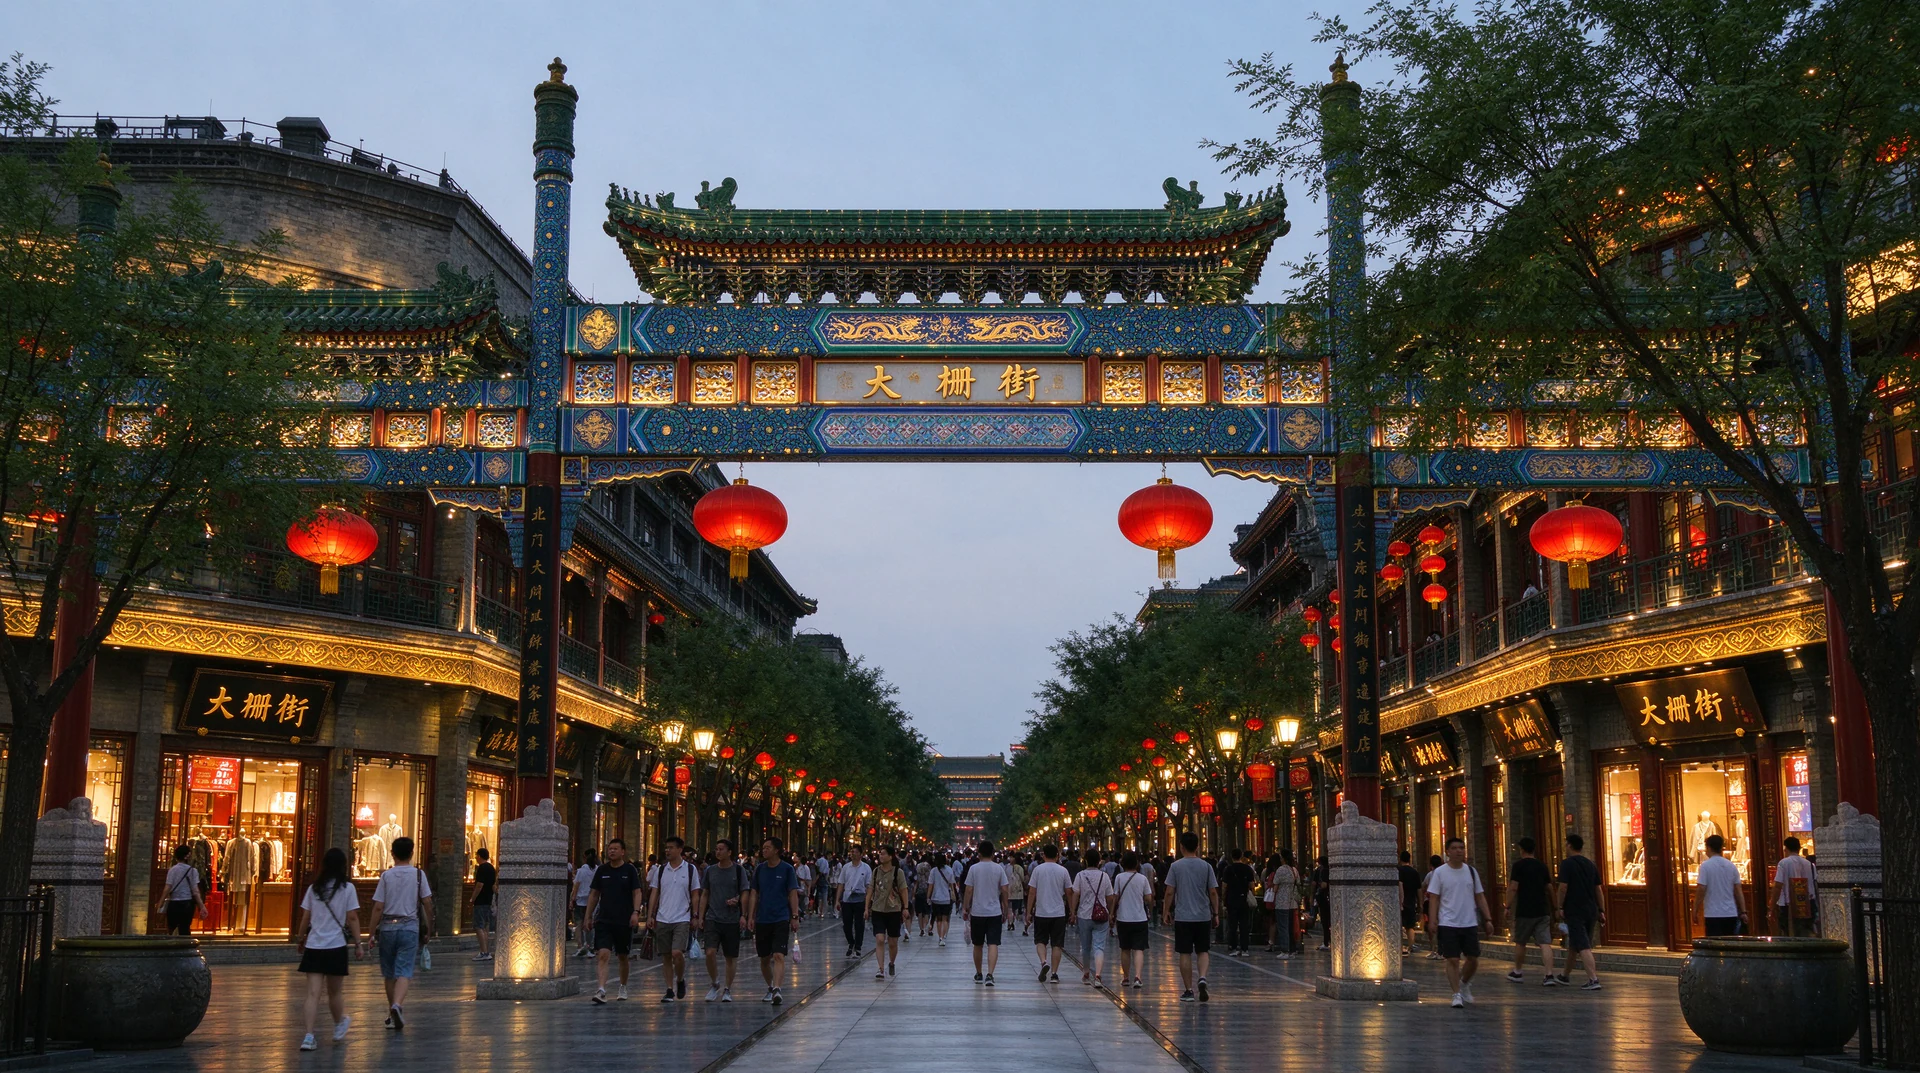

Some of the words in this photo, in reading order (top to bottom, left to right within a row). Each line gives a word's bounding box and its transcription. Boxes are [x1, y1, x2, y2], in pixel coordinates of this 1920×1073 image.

[863, 364, 1040, 401] 大栅街
[203, 686, 310, 728] 大栅街
[1640, 688, 1723, 726] 大栅街
